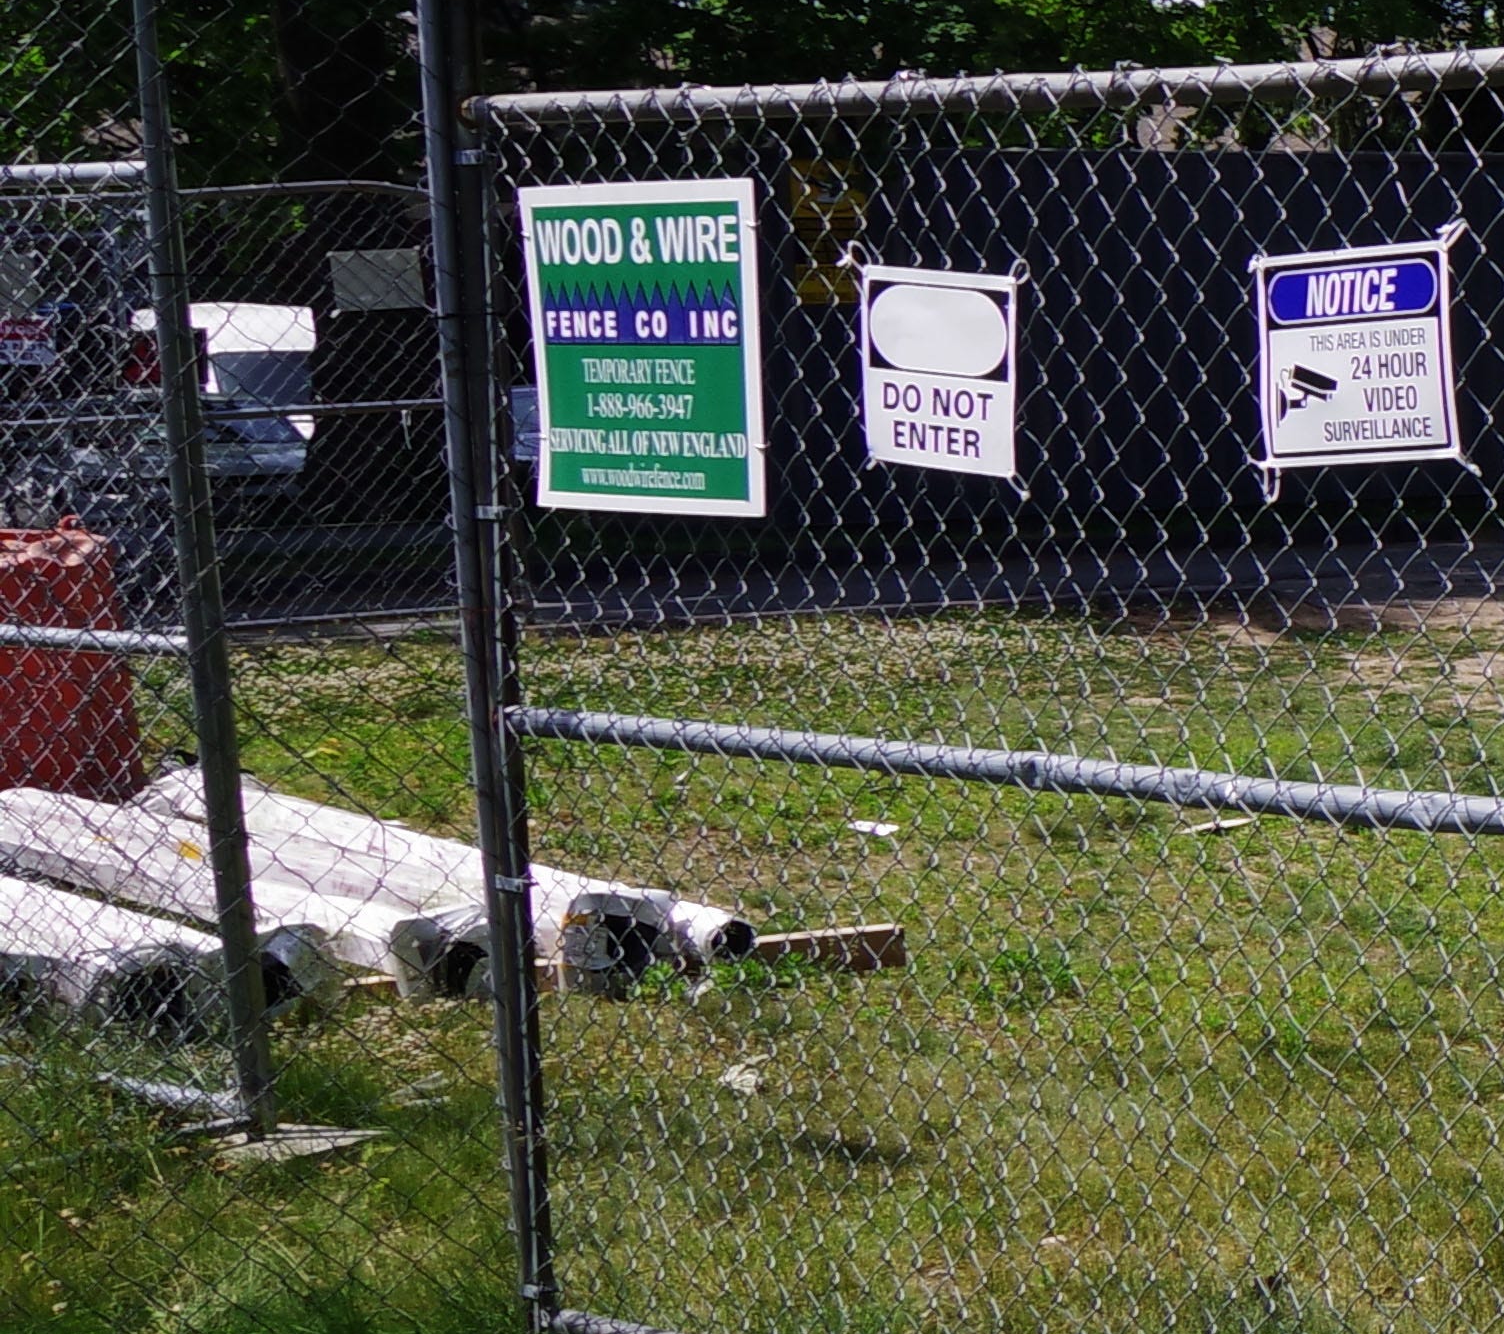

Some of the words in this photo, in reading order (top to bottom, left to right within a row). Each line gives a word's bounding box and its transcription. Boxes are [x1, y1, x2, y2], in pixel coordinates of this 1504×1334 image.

[536, 218, 623, 266] WOOD
[630, 217, 653, 265] &
[656, 215, 740, 264] WIRE
[1305, 268, 1398, 317] NOTICE
[546, 310, 618, 338] FENCE
[635, 310, 668, 338] CO
[689, 310, 738, 338] INC
[1310, 334, 1334, 352] THIS
[1337, 332, 1365, 350] AREA
[1369, 331, 1381, 349] IS
[1384, 328, 1426, 347] UNDER
[581, 358, 653, 384] TEMPORARY
[655, 359, 696, 385] FENCE
[1351, 356, 1372, 380] 24
[1377, 352, 1428, 379] HOUR
[586, 393, 694, 420] 1-888-966-3947
[882, 382, 922, 413] DO
[932, 387, 993, 421] NOT
[1363, 385, 1418, 413] VIDEO
[550, 427, 606, 454] SERVICING
[606, 430, 631, 455] ALL
[632, 431, 649, 456] OF
[651, 431, 680, 457] NEW
[683, 432, 747, 459] ENGLAND
[893, 420, 981, 458] ENTER
[1324, 417, 1432, 442] SURVEILLANCE
[581, 463, 706, 490] www.woodwirefence.com
